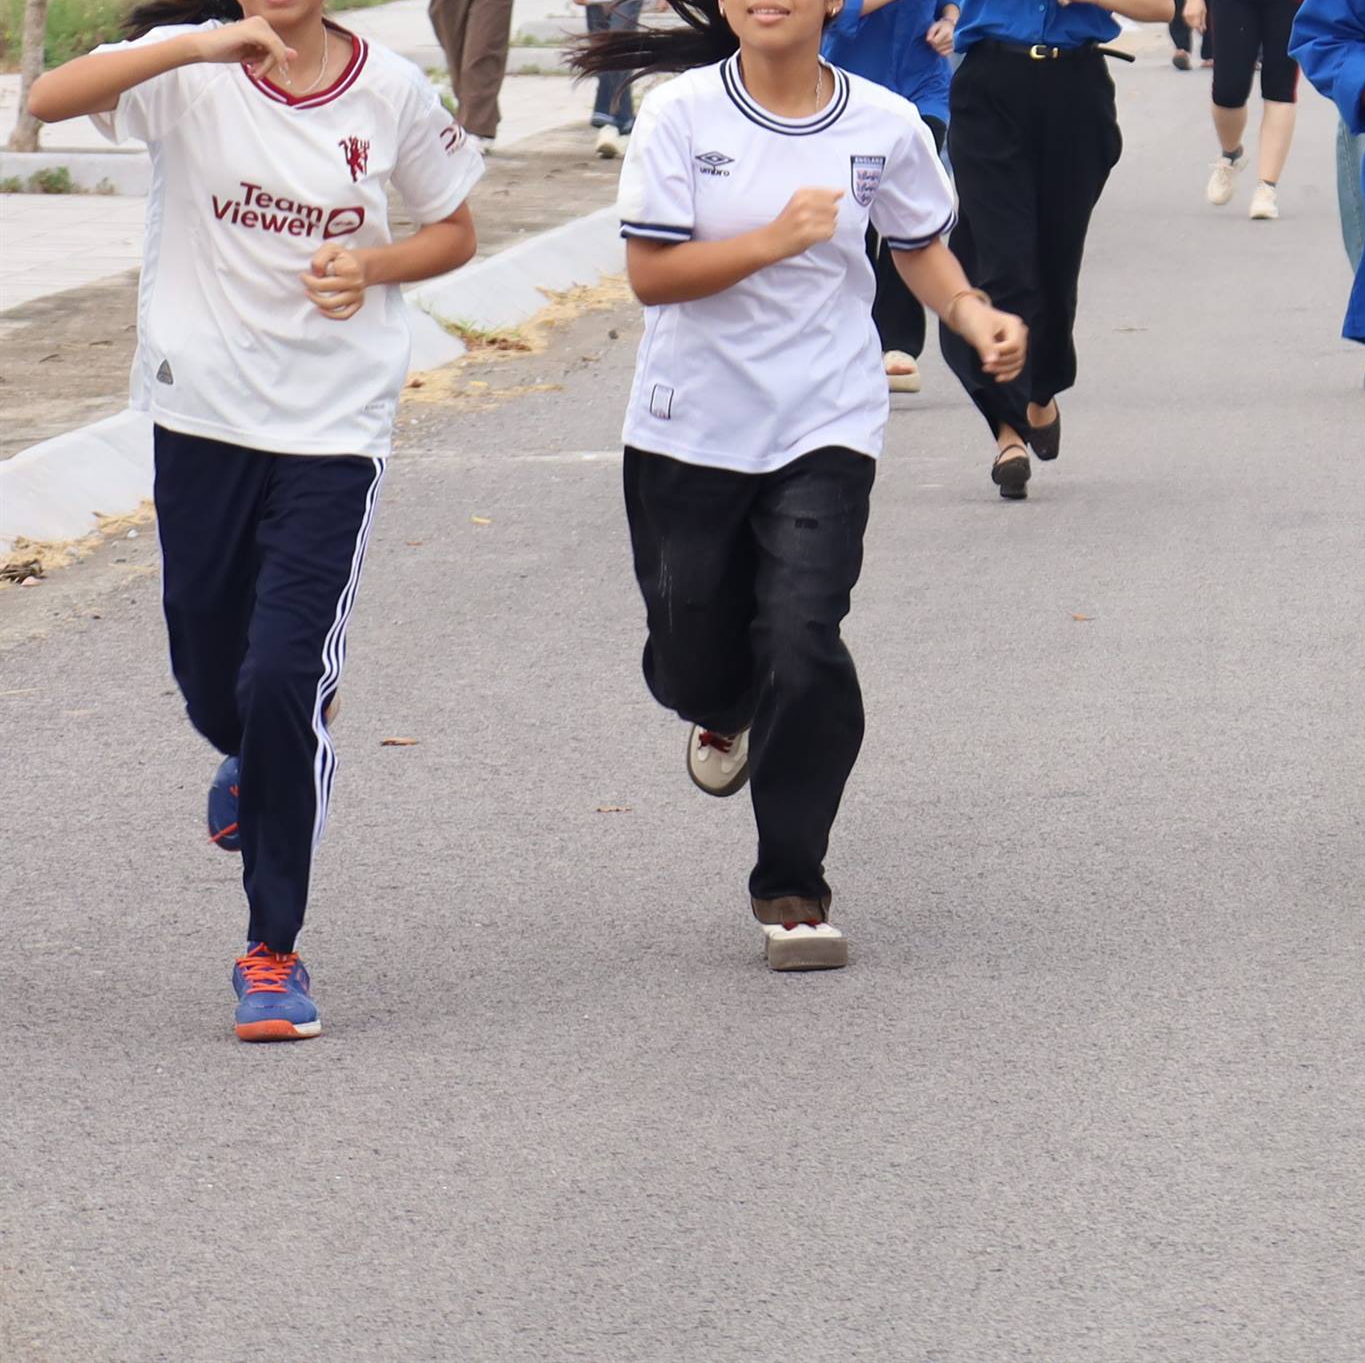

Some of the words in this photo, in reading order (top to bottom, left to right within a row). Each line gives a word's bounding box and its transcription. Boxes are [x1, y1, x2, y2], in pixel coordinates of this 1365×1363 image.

[699, 165, 730, 177] umbro
[211, 194, 319, 237] Viewer
[239, 181, 324, 223] Team
